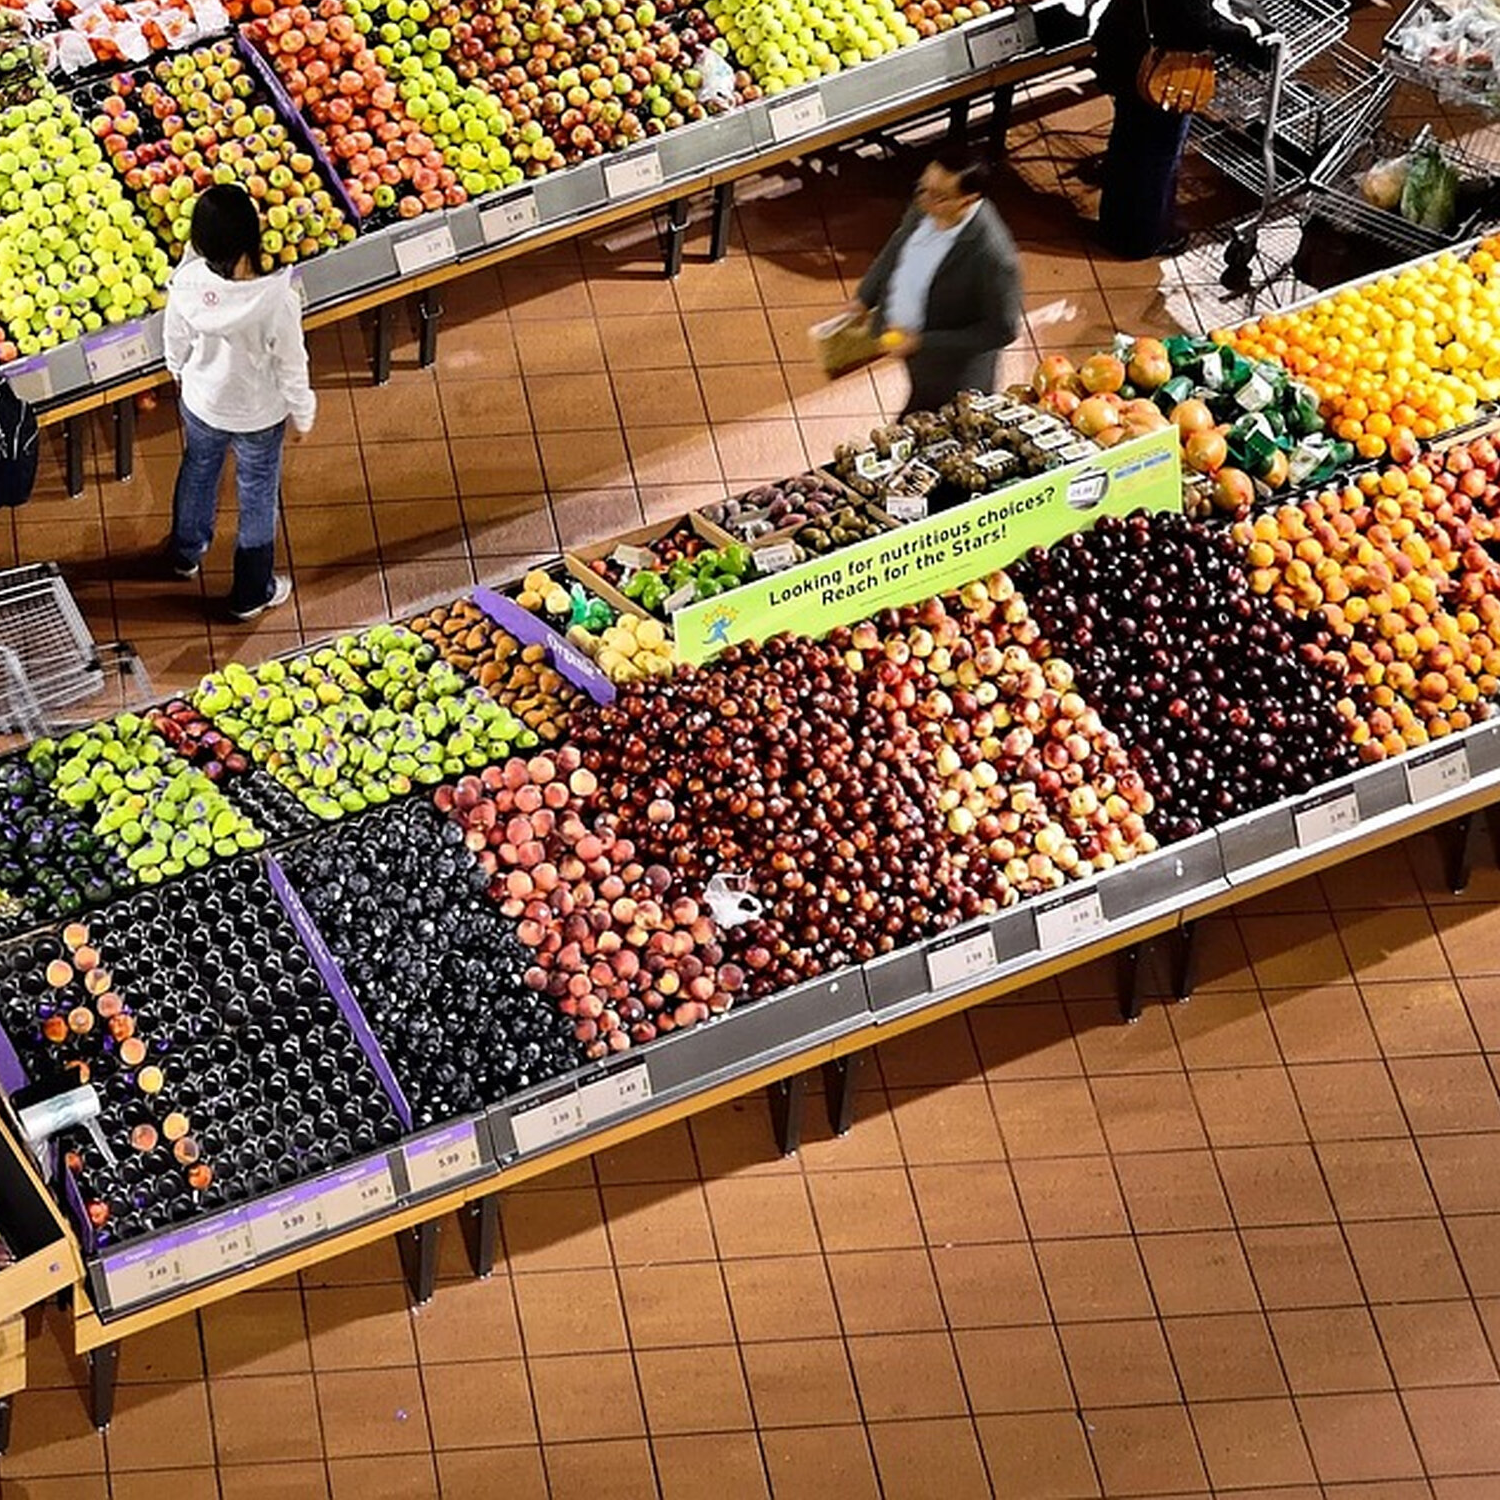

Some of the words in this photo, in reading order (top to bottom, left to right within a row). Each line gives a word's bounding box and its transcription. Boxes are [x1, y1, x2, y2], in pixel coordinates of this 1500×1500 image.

[768, 569, 842, 607] Looking
[847, 556, 873, 577] for
[879, 520, 971, 565] nutritious
[977, 486, 1056, 529] choices?
[821, 574, 879, 606] Reach
[884, 562, 910, 583] for
[916, 550, 947, 571] the
[952, 523, 1007, 558] Stars!
